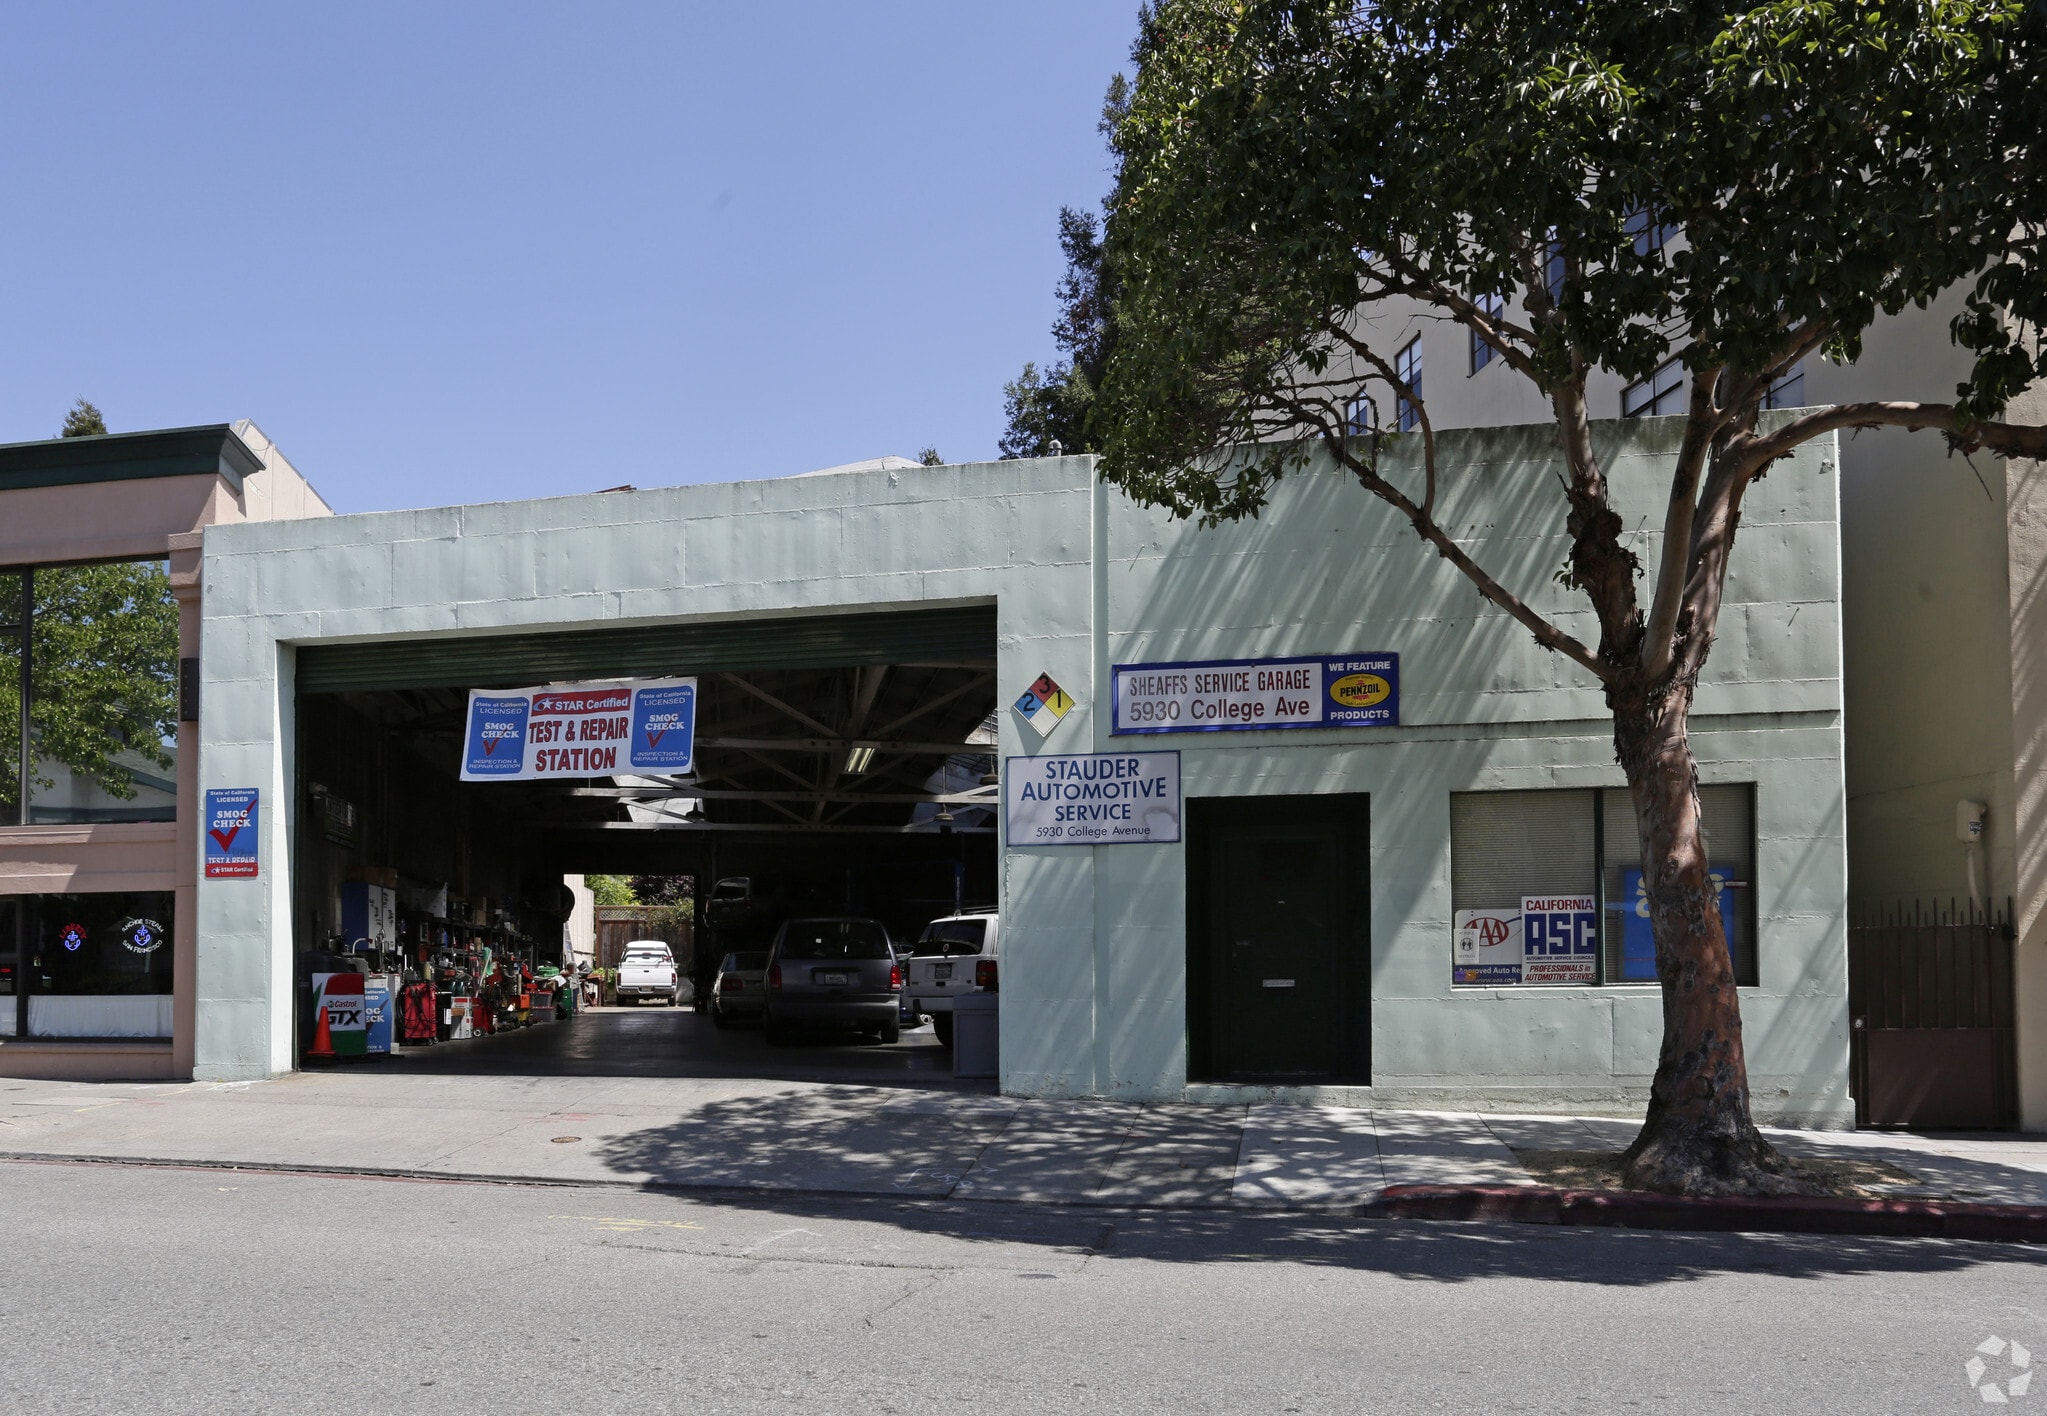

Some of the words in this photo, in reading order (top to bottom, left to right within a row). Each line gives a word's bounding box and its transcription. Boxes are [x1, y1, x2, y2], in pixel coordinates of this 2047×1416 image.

[1328, 663, 1344, 671] WE
[1346, 661, 1391, 670] FEATURE
[1039, 676, 1050, 694] 3
[1130, 675, 1188, 696] SHEAFFS
[1195, 672, 1250, 694] SERVICE
[1258, 670, 1310, 691] GARAGE
[1340, 683, 1380, 697] PENNZOIL
[555, 700, 584, 710] STAR
[586, 697, 628, 709] Certified
[644, 698, 686, 706] LICENSED
[1023, 693, 1035, 712] 2
[1056, 690, 1062, 708] 1
[1130, 700, 1180, 721] 5930
[1191, 699, 1265, 722] College
[1275, 696, 1310, 716] Ave
[1330, 710, 1389, 720] PRODUCTS
[649, 714, 679, 722] SMOG
[529, 720, 562, 744] TEST
[565, 720, 575, 742] &
[580, 717, 629, 741] REPAIR
[645, 722, 685, 730] CHECK
[535, 746, 617, 772] STATION
[1046, 758, 1140, 780] STAUDER
[1020, 777, 1166, 801] AUTOMOTIVE
[217, 810, 248, 818] SMOG
[1055, 804, 1131, 822] SERVICE
[213, 819, 251, 828] CHECK
[1036, 826, 1063, 837] 5930
[1068, 826, 1107, 838] College
[1112, 826, 1150, 835] Avenue
[1526, 899, 1593, 911] CALIFORNIA
[59, 923, 87, 939] LIBERTY
[1525, 913, 1595, 955] ASC
[122, 940, 133, 951] SAN
